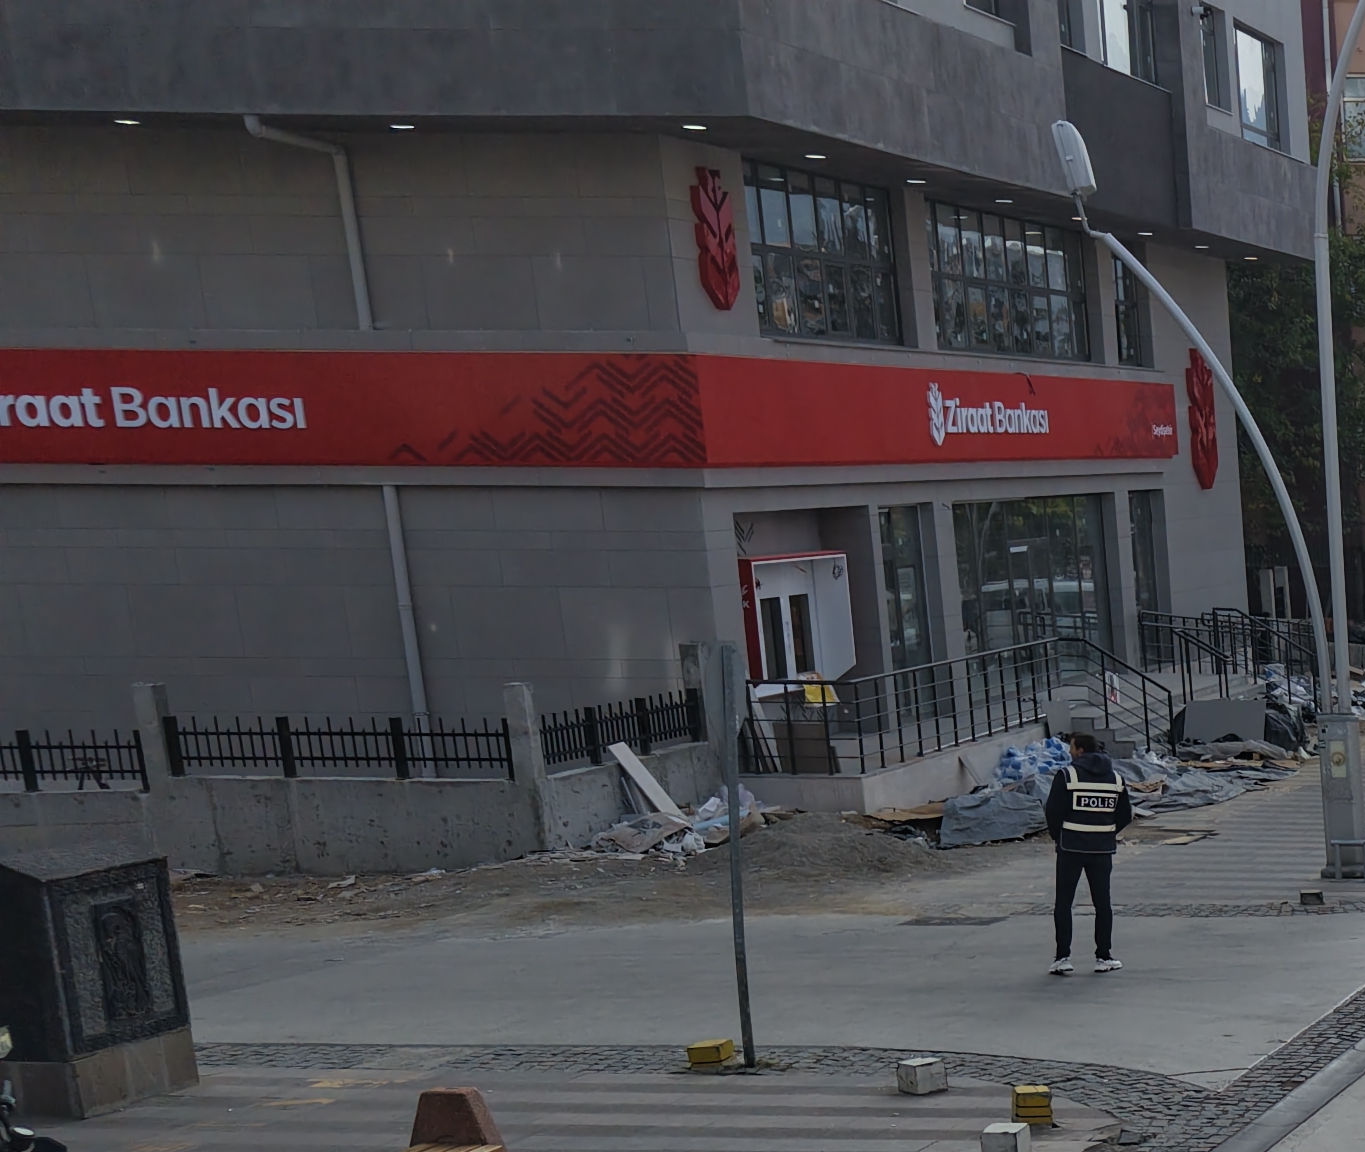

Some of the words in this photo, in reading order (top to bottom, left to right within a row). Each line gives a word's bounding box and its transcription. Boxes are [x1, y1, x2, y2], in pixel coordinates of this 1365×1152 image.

[110, 386, 307, 429] Bankası
[945, 397, 993, 434] Ziraat
[993, 401, 1049, 434] Bankası
